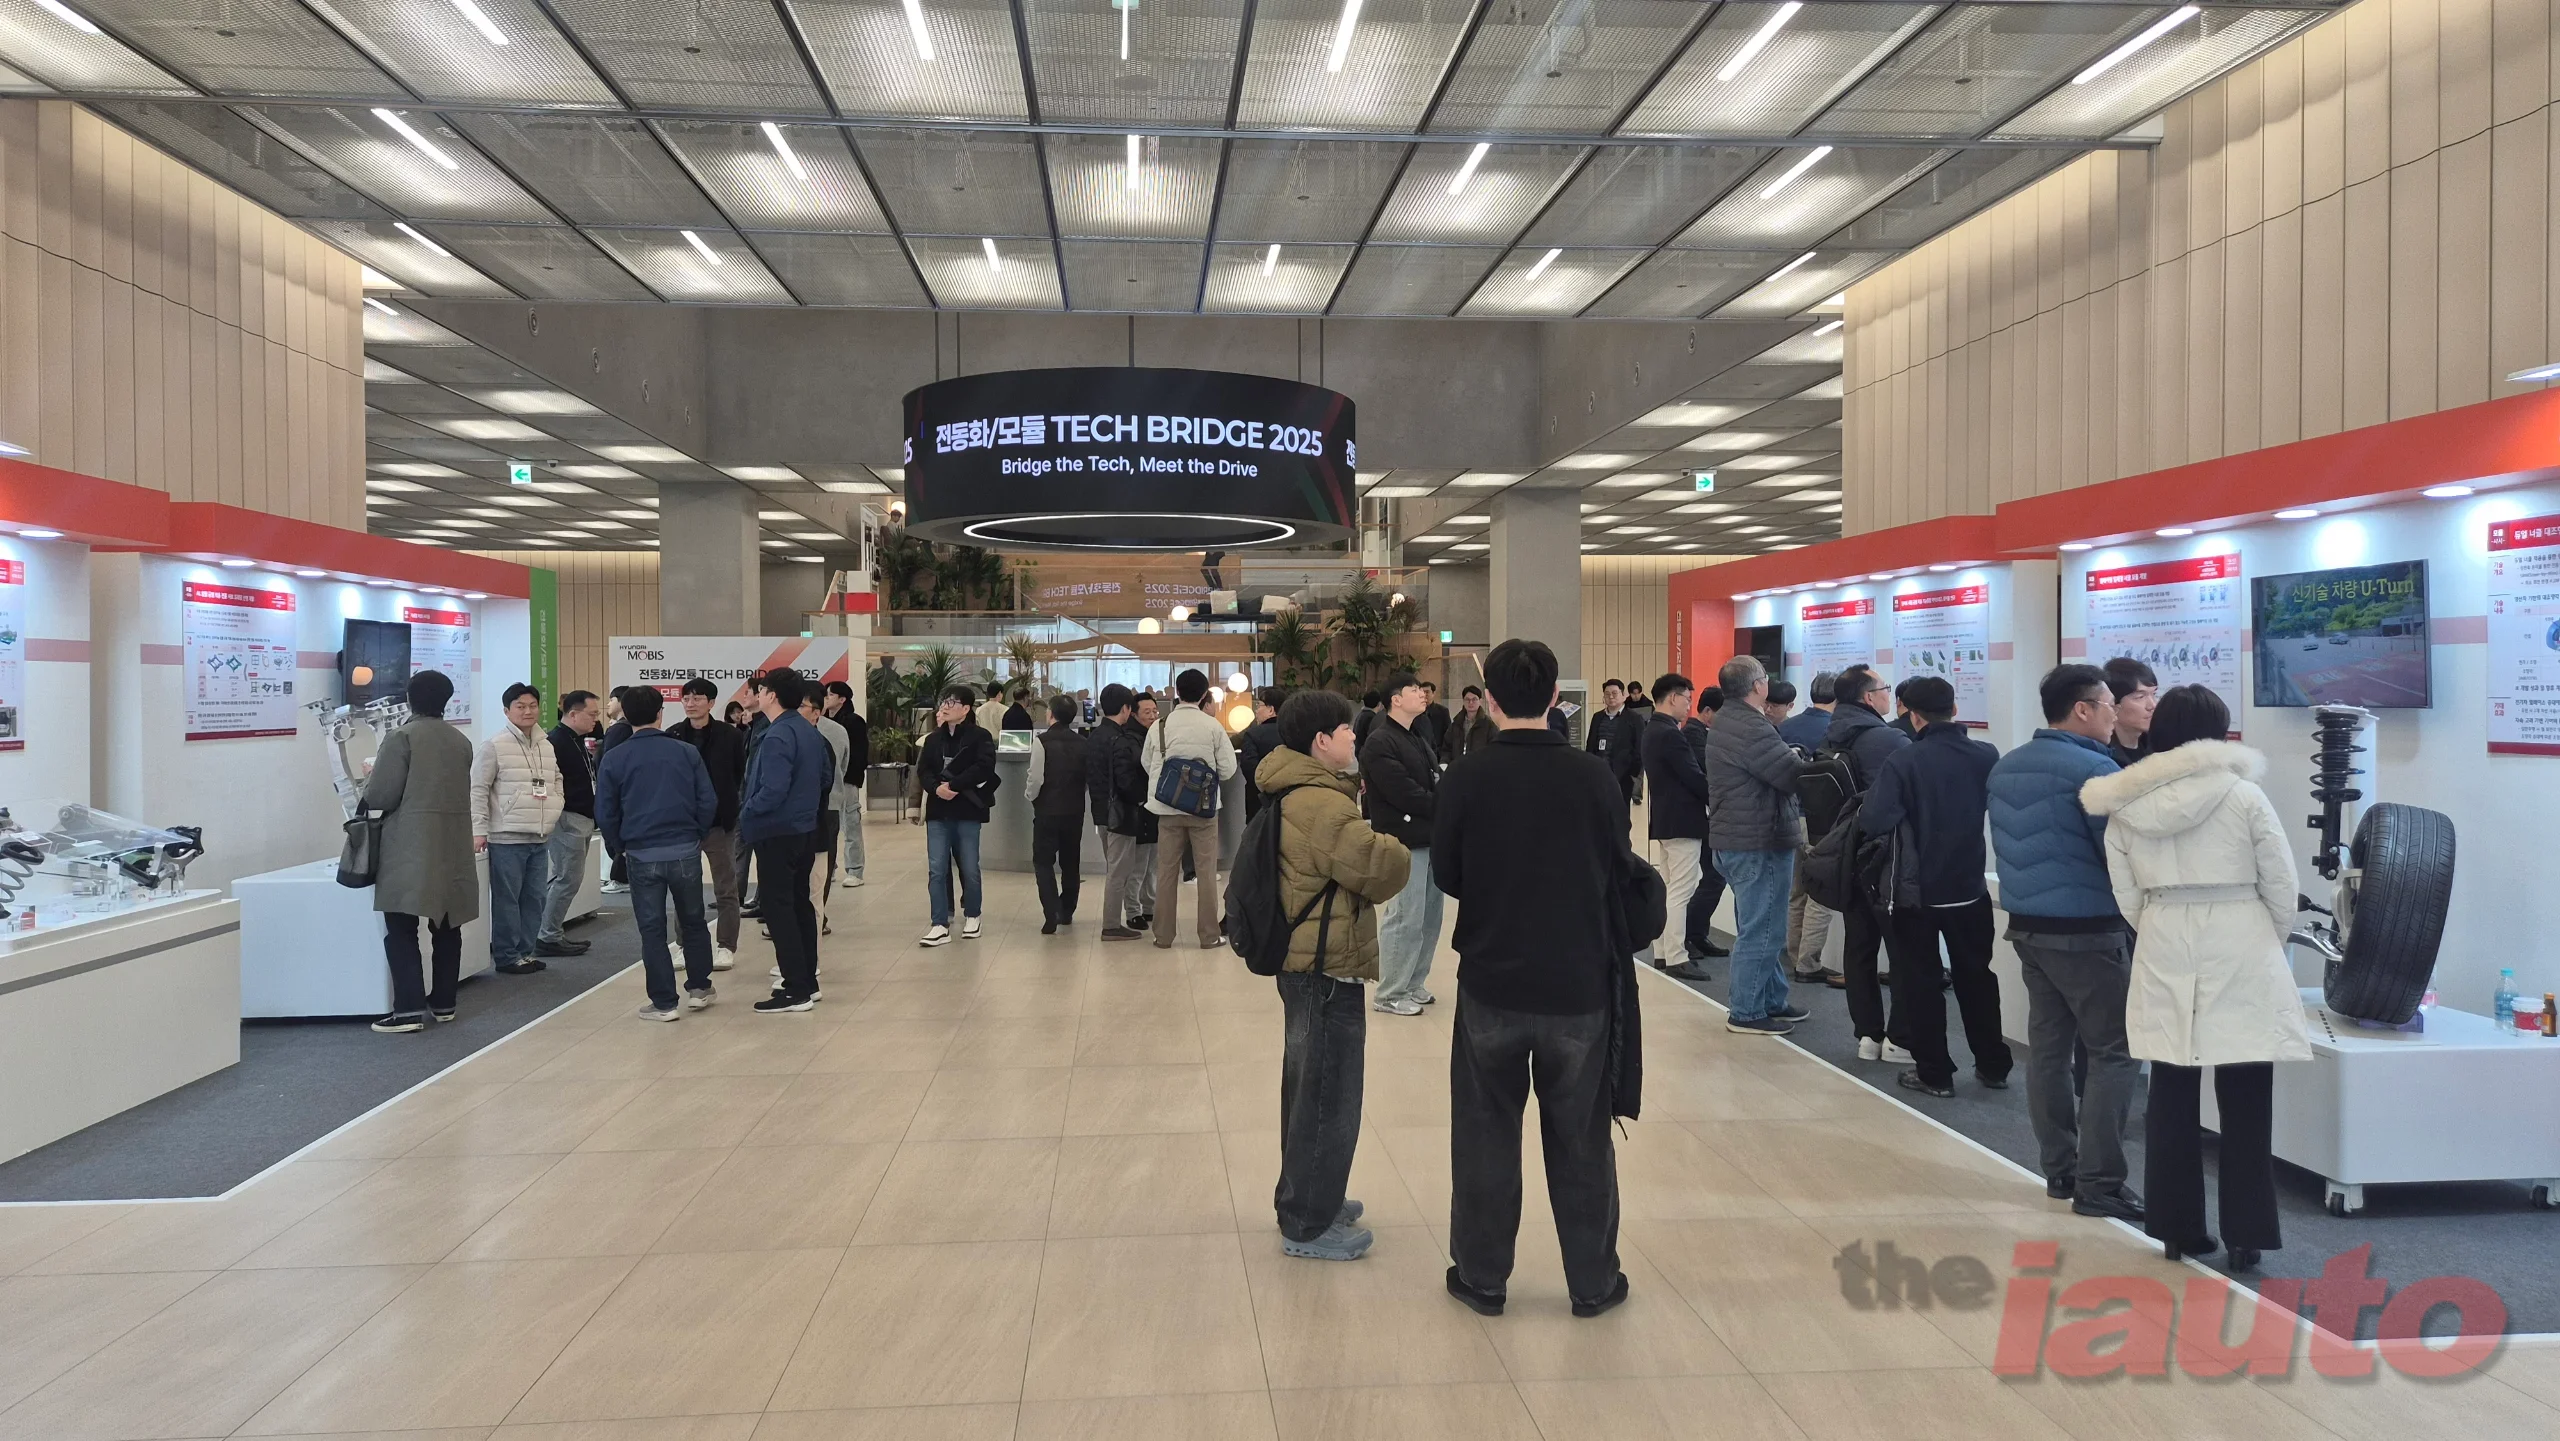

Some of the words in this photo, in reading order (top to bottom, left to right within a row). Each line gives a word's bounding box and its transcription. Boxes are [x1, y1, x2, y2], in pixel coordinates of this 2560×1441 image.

[936, 415, 1046, 453] 전동화/모듈
[1050, 414, 1138, 443] TECH
[1147, 415, 1264, 449] BRIDGE
[1268, 424, 1323, 457] 2025
[1002, 457, 1051, 477] Bridge
[1056, 456, 1083, 472] the
[1088, 455, 1134, 475] Tech,
[1139, 456, 1183, 473] Meet
[1188, 458, 1214, 474] the
[1219, 459, 1258, 478] Drive
[2292, 583, 2329, 603] 신기술
[2331, 579, 2358, 600] 차량
[2361, 577, 2415, 596] U-Turn
[627, 650, 665, 661] MOBIS
[638, 668, 697, 681] 전동화/모듈
[699, 669, 733, 680] TECH
[660, 688, 680, 698] 모듈
